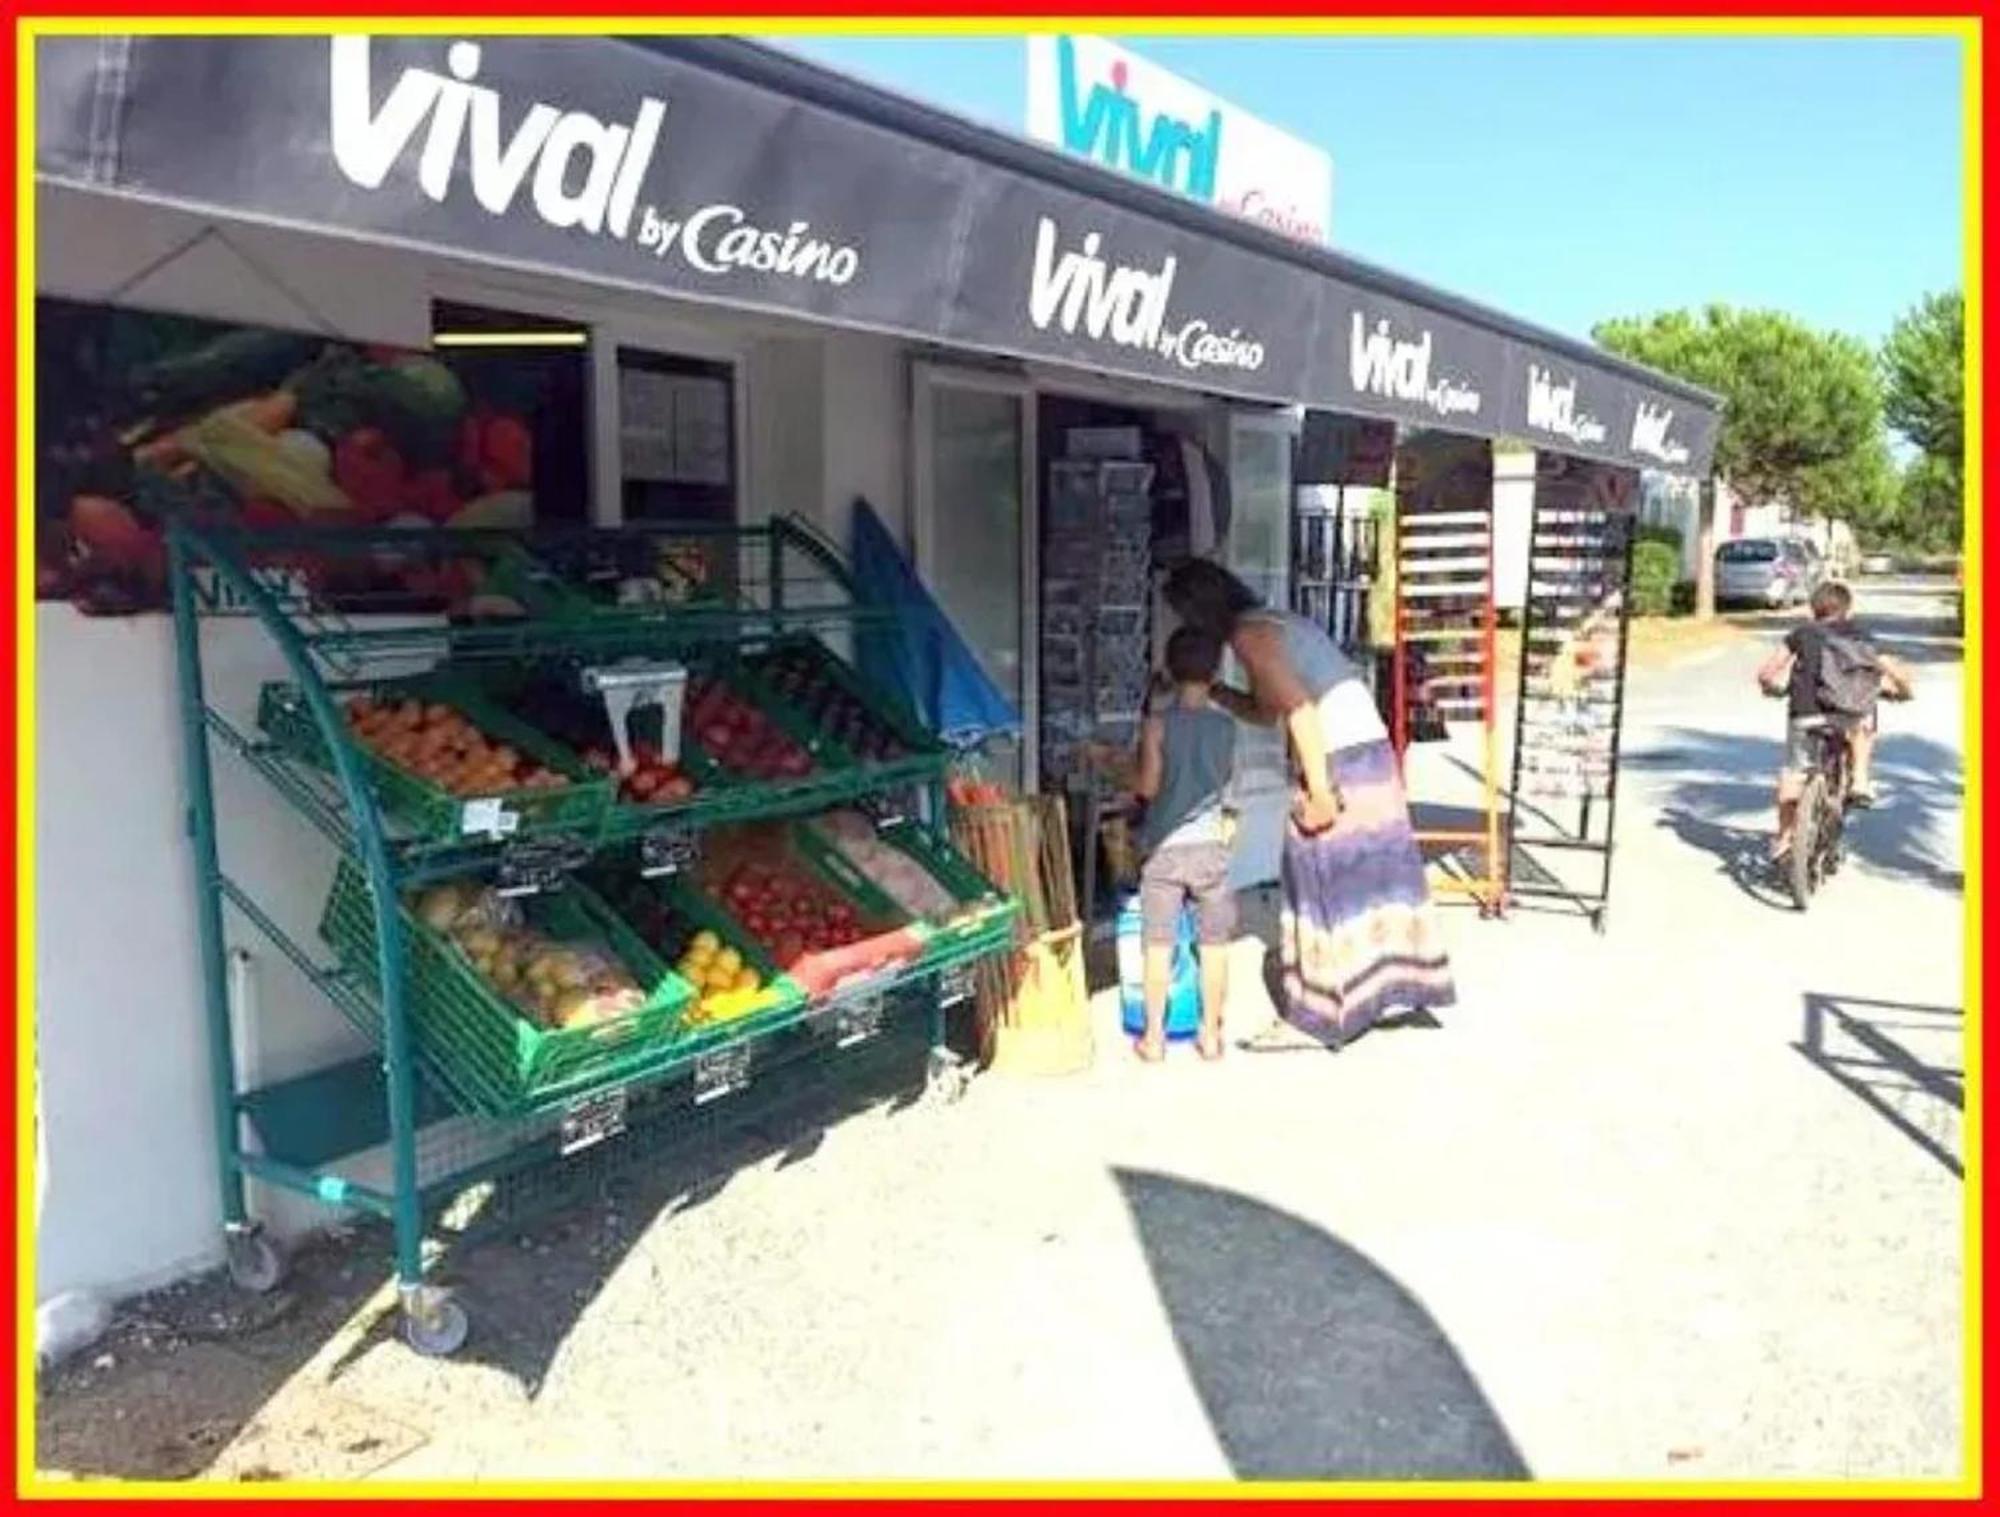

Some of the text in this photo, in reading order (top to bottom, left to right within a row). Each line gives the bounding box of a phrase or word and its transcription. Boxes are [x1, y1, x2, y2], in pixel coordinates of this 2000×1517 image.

[330, 35, 862, 286] Vival by Casino
[1057, 35, 1222, 200] Vival
[1029, 215, 1177, 350] Vival
[1175, 319, 1264, 370] Casino
[1350, 311, 1432, 402] Vival
